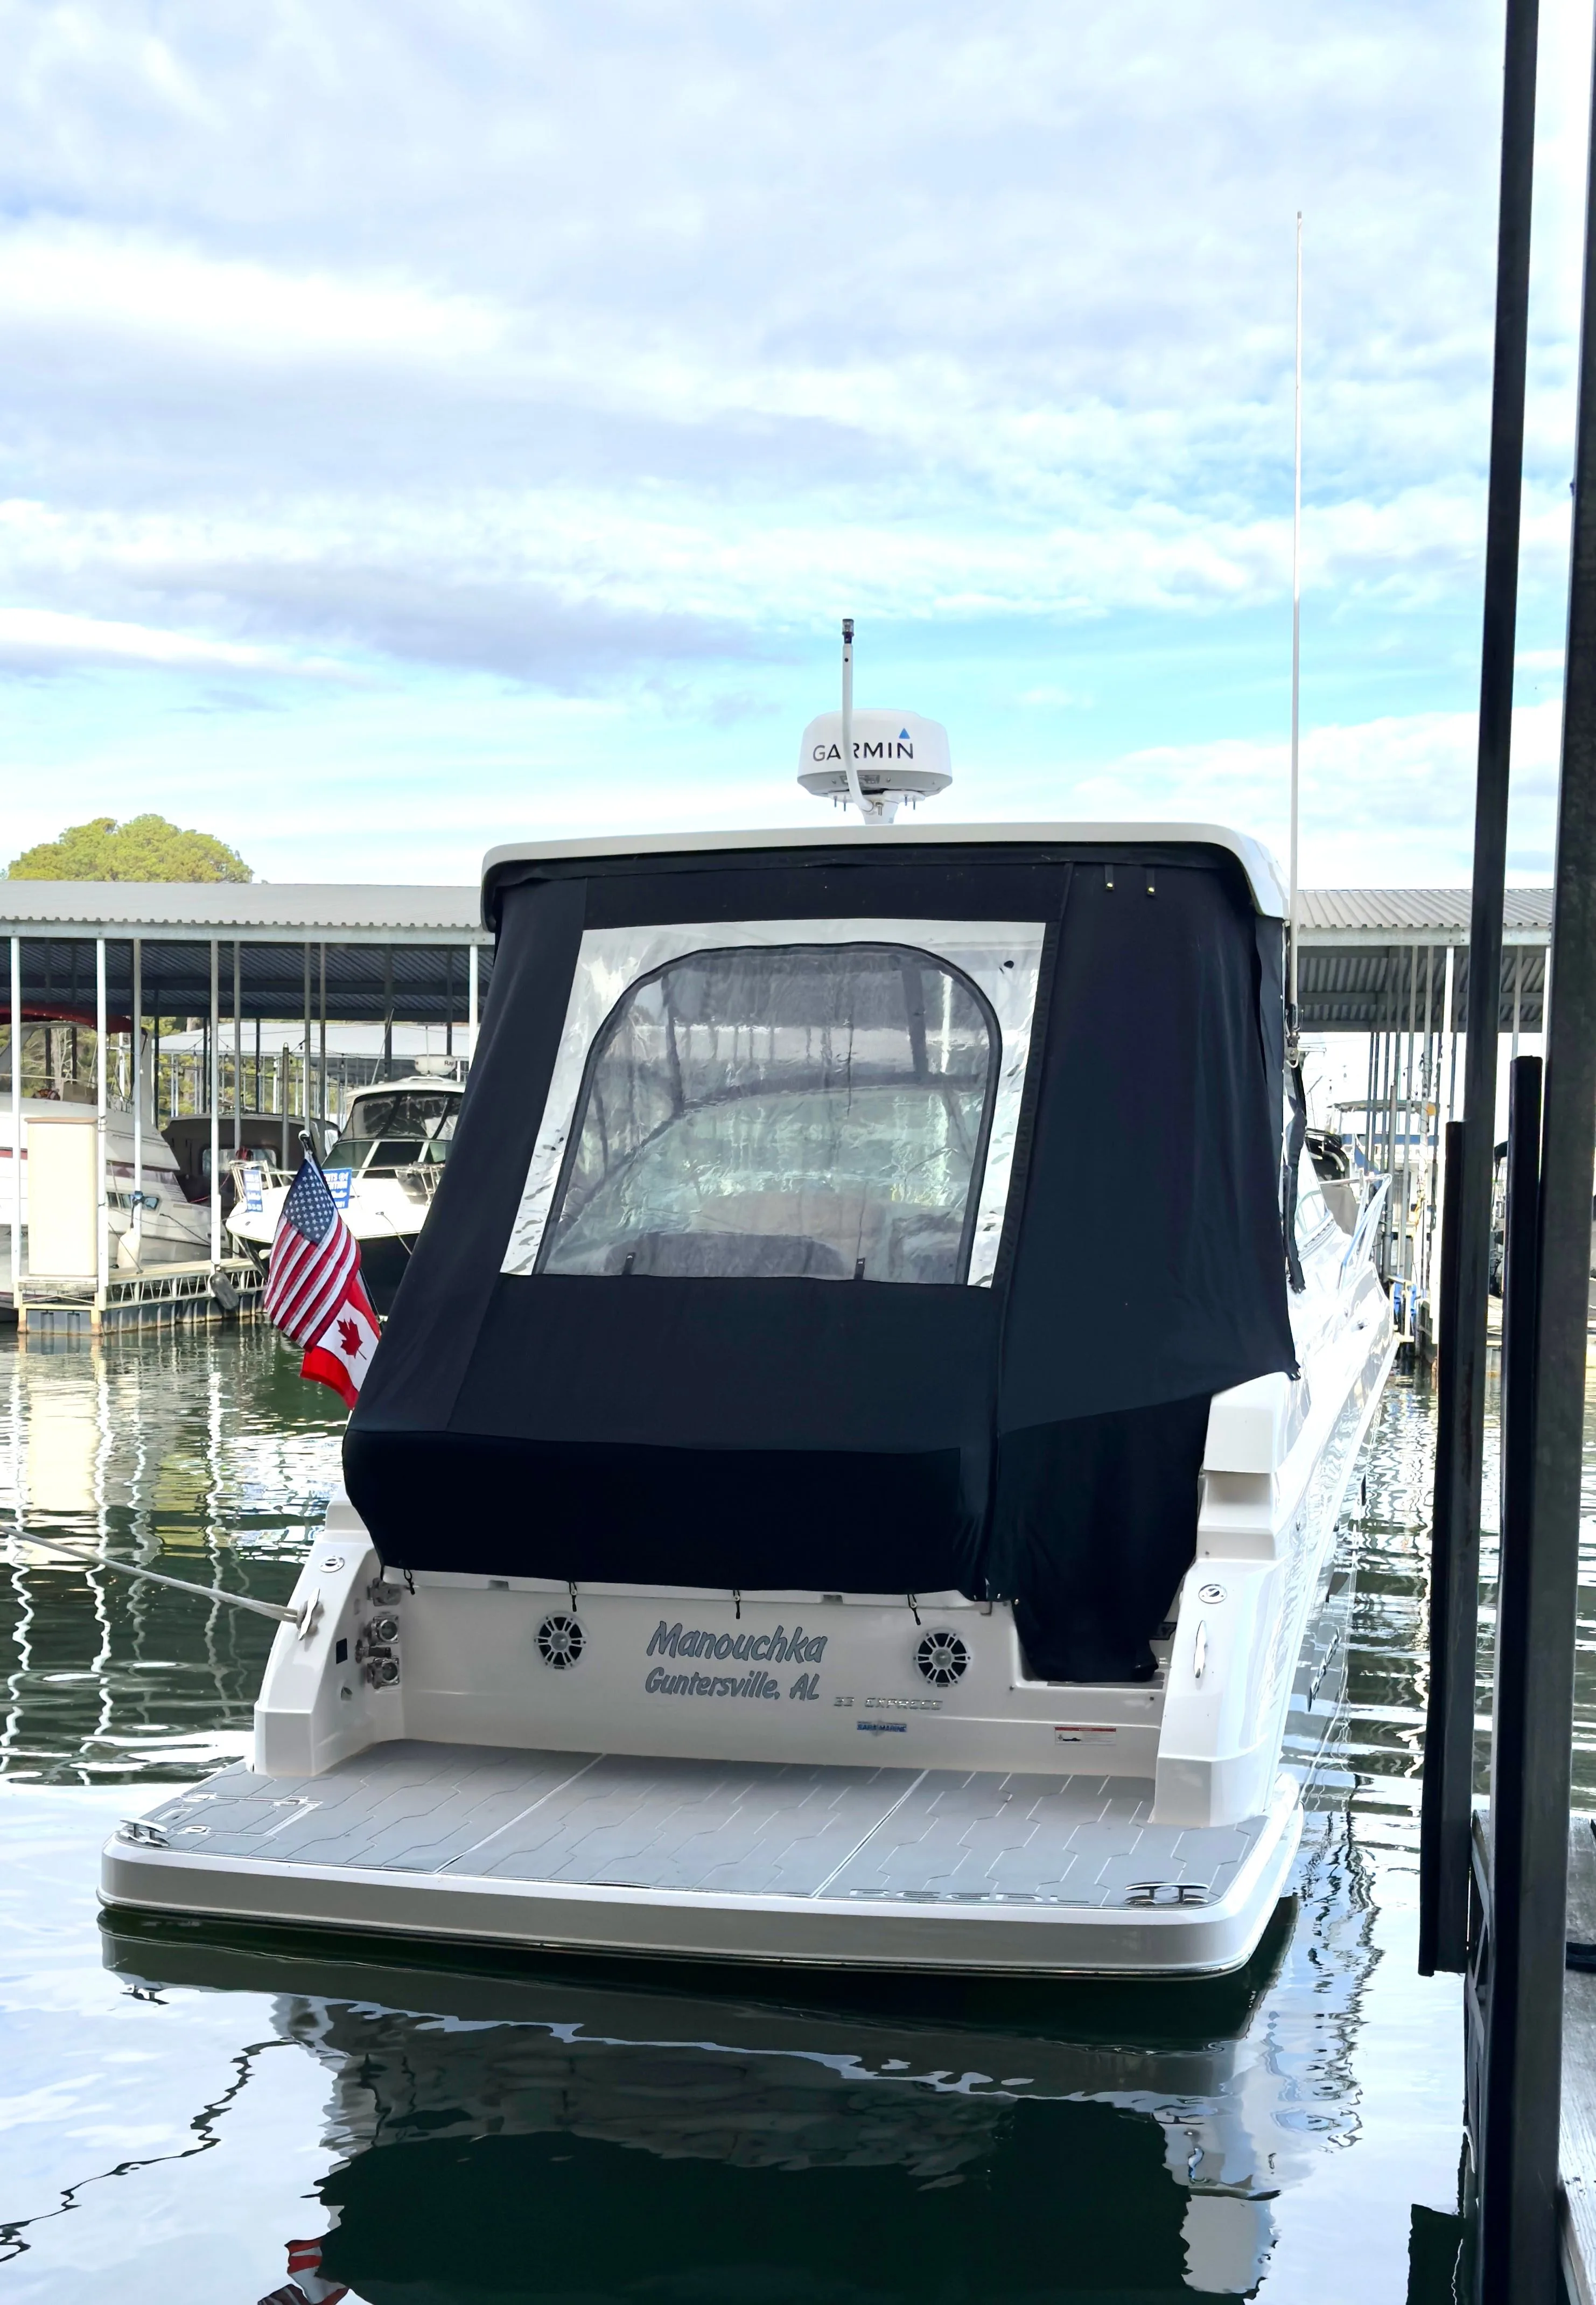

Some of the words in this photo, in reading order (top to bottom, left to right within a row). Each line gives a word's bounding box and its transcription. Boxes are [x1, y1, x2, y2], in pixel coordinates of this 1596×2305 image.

[646, 1620, 829, 1664] Manouchka
[789, 1672, 821, 1701] AL
[849, 1889, 1090, 1903] REGAL
